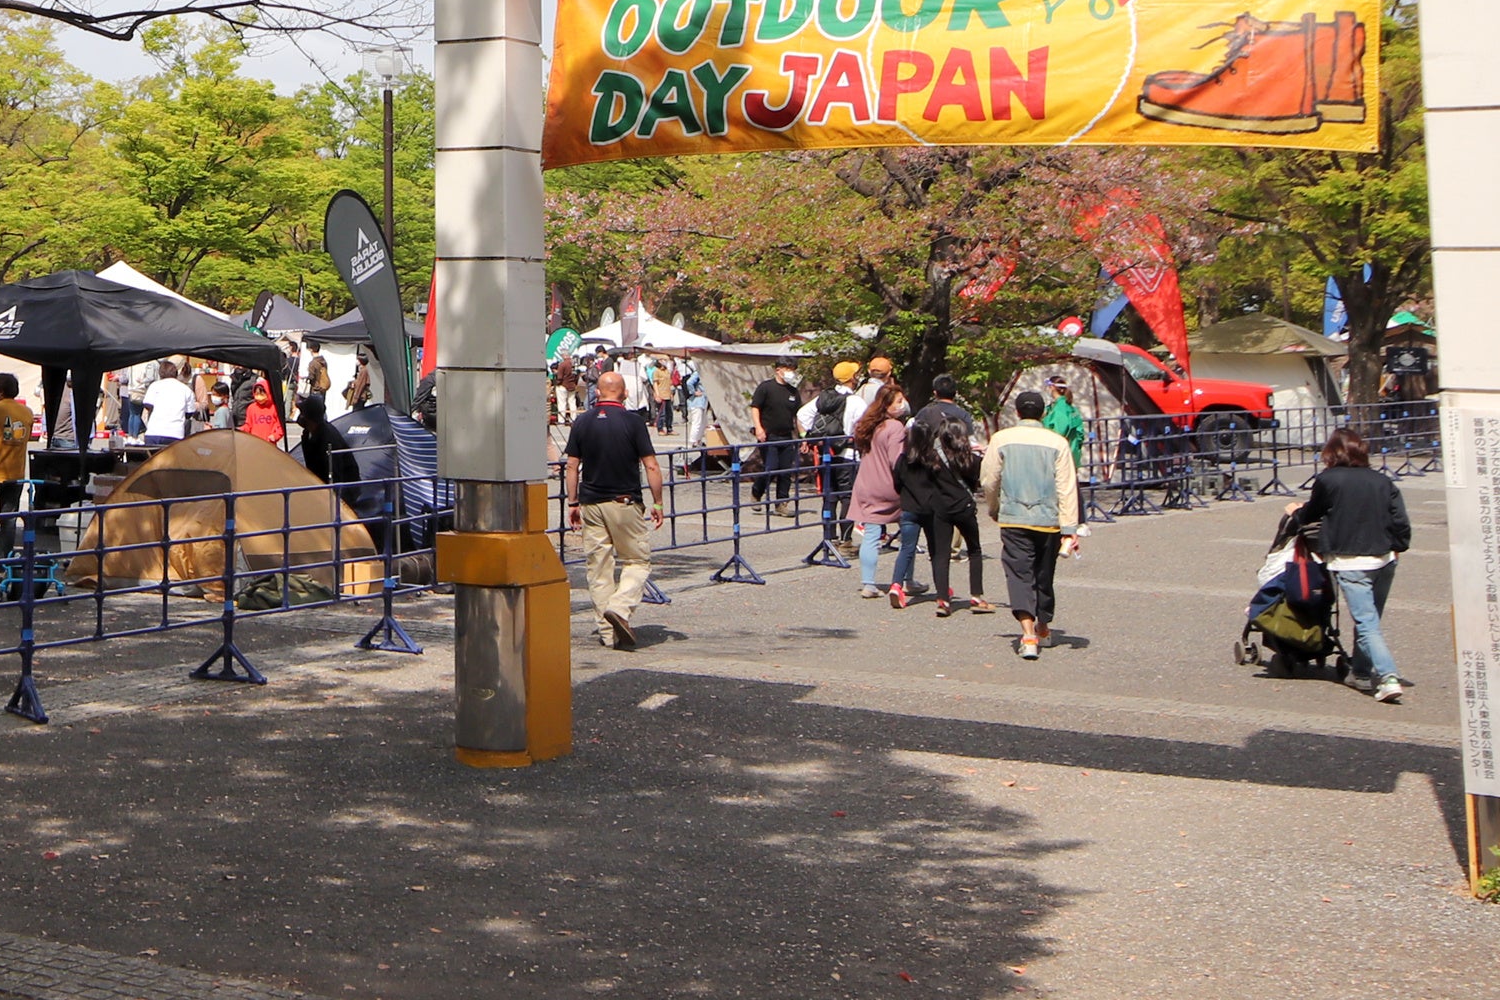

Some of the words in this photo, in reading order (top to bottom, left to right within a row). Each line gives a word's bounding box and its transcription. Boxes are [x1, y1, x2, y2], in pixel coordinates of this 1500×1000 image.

[588, 60, 754, 146] DAY
[742, 45, 1050, 130] JAPAN
[1462, 650, 1481, 777] 代々木公園サービスセンター
